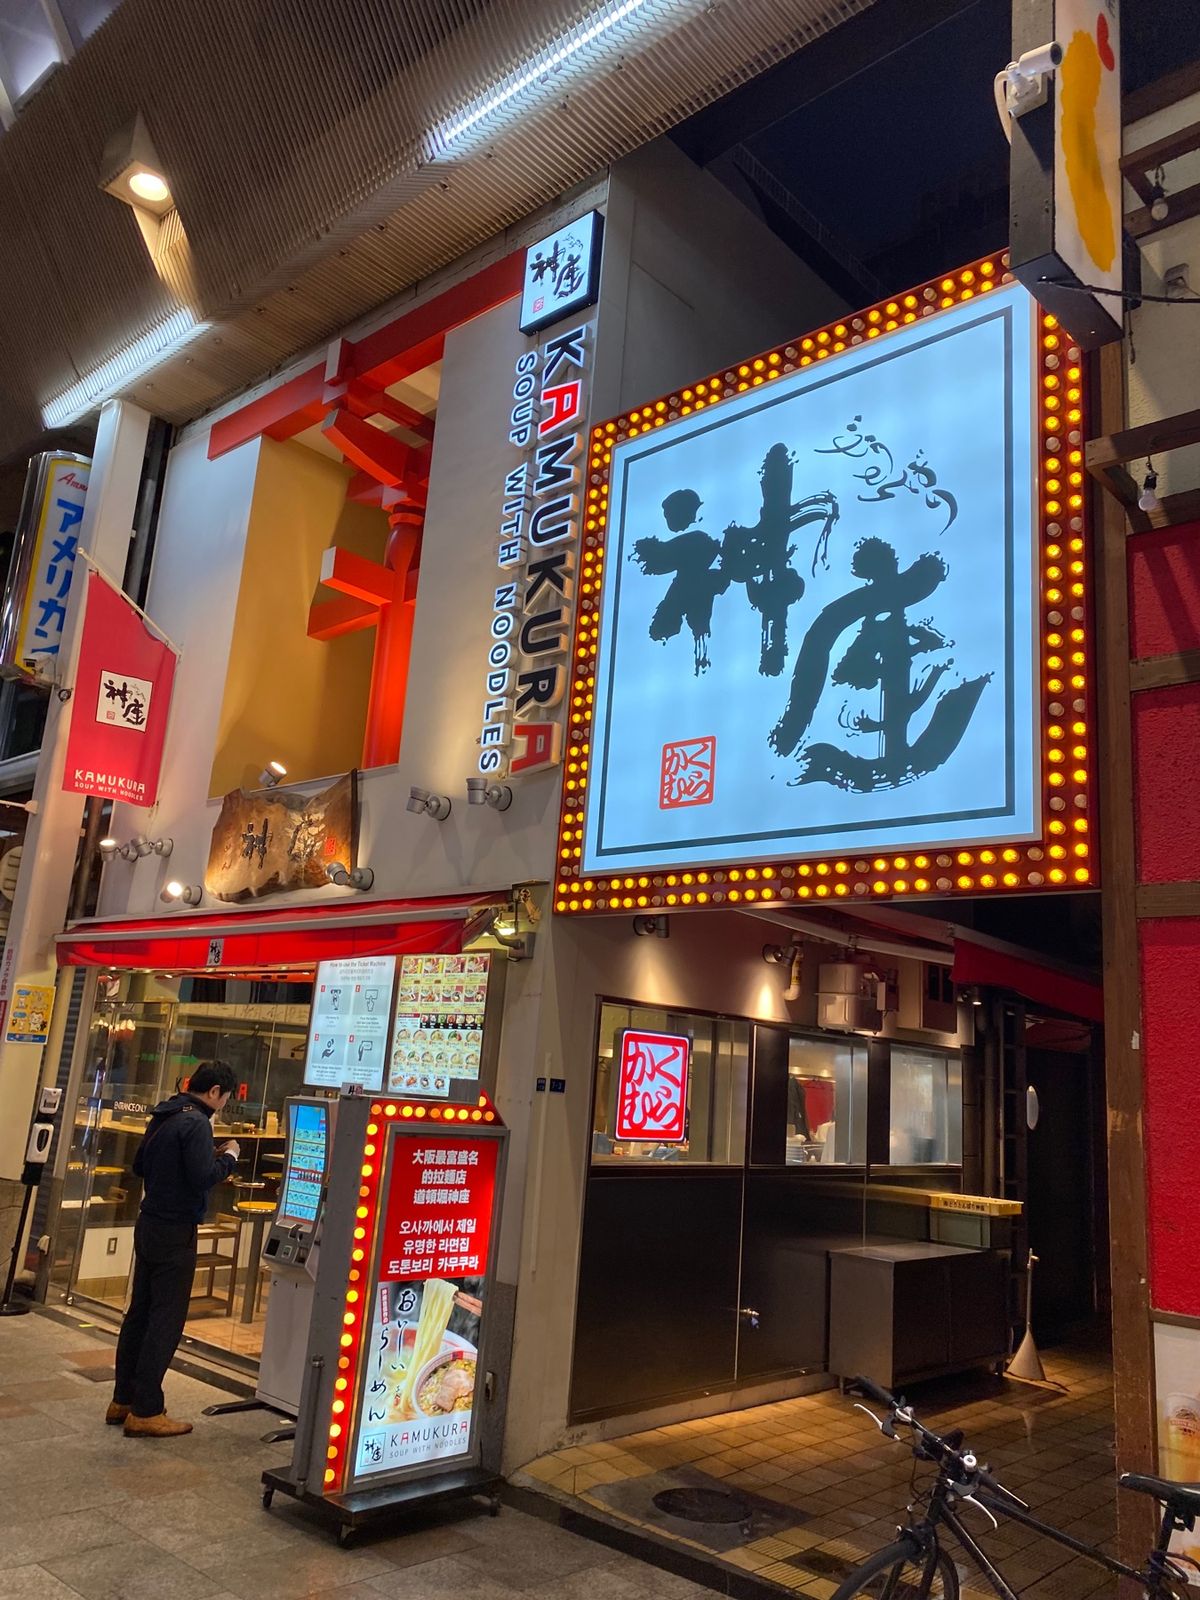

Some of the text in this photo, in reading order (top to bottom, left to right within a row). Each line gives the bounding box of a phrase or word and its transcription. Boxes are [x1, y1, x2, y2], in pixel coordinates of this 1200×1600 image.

[479, 350, 538, 773] SOUP WITH NOODLES
[508, 324, 587, 777] KAMUKURA
[74, 781, 95, 790] SOUP
[98, 785, 117, 794] WITH
[75, 769, 145, 794] KAMUKURA
[399, 1218, 477, 1235] 오사까에서 제일
[403, 1237, 470, 1255] 유명한 라면집
[387, 1255, 479, 1275] 도톤보리 카무쿠라
[390, 1421, 468, 1447] KAMUKURA
[390, 1437, 466, 1459] SOUP WITH NOODLES
